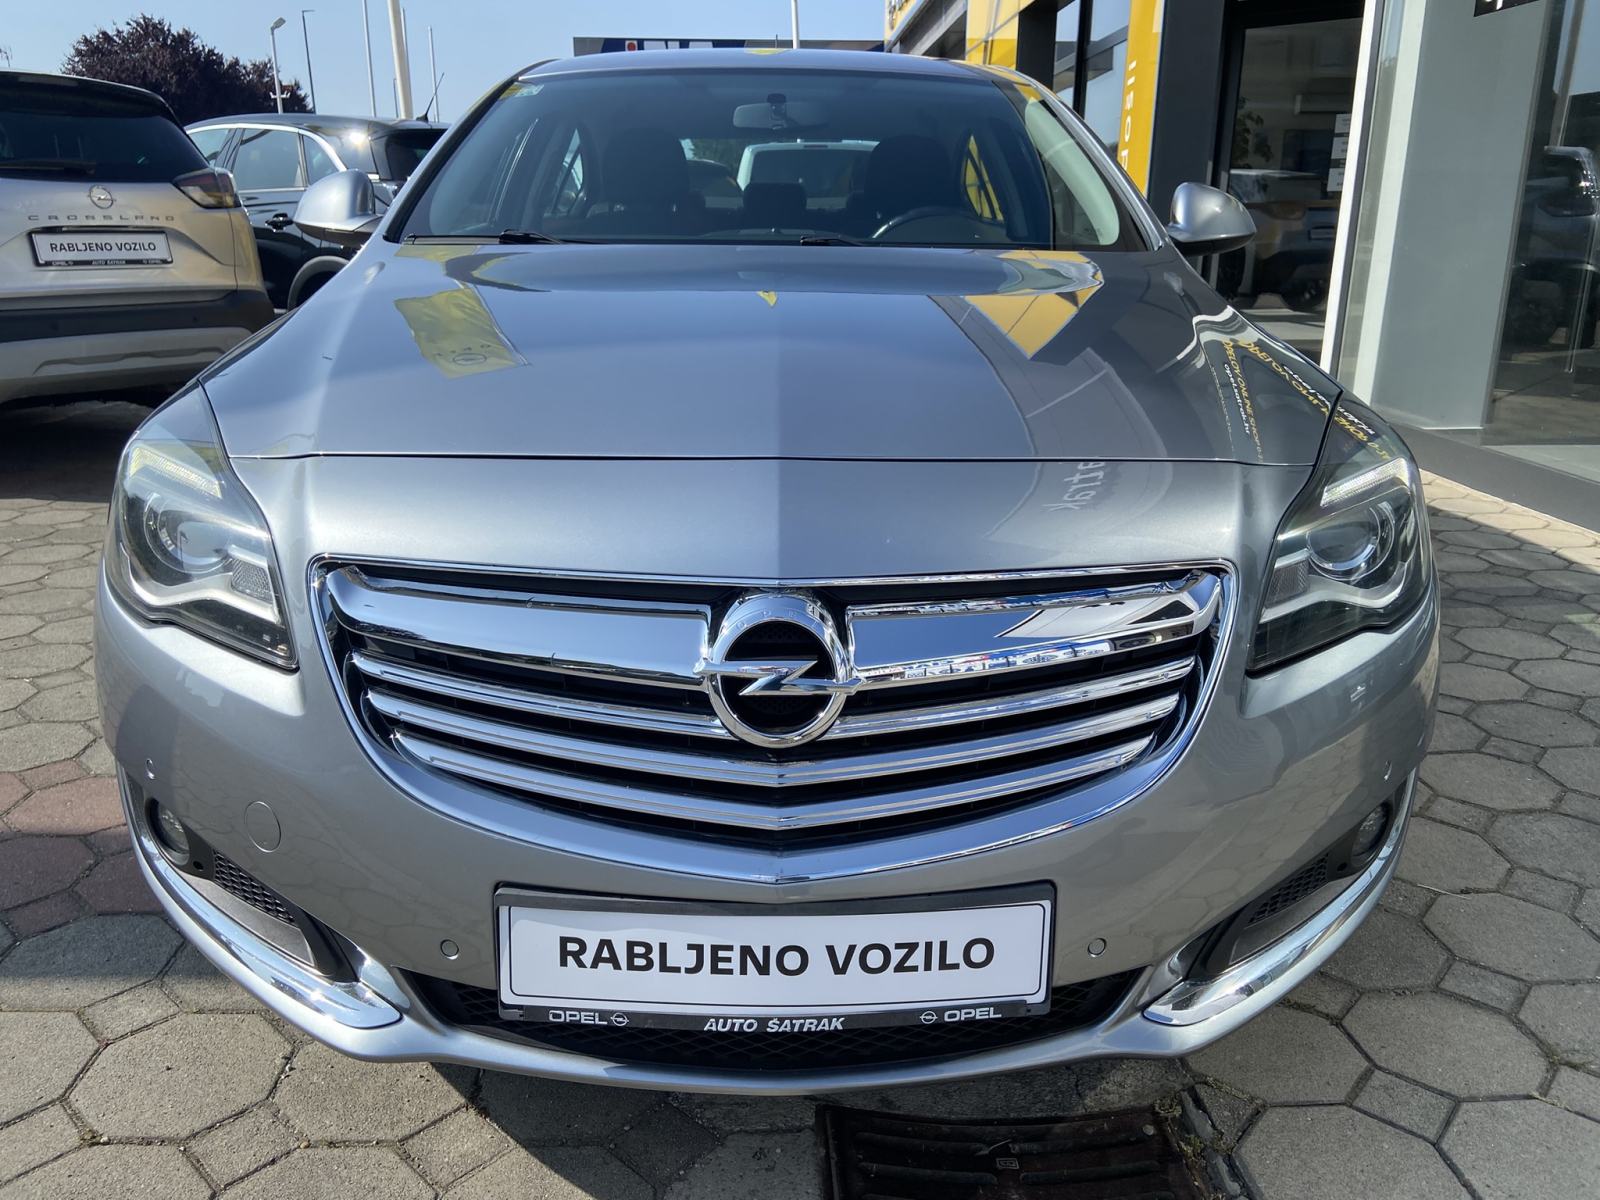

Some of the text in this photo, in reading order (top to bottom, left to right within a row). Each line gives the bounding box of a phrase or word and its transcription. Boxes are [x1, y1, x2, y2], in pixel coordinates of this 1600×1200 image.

[50, 241, 156, 253] RABLJENO VOZILO
[559, 936, 995, 976] RABLJENO VOZILO
[548, 1009, 608, 1025] OPEL
[943, 1007, 1002, 1022] OPEL
[703, 1017, 845, 1033] AUTO ŠATRAK
